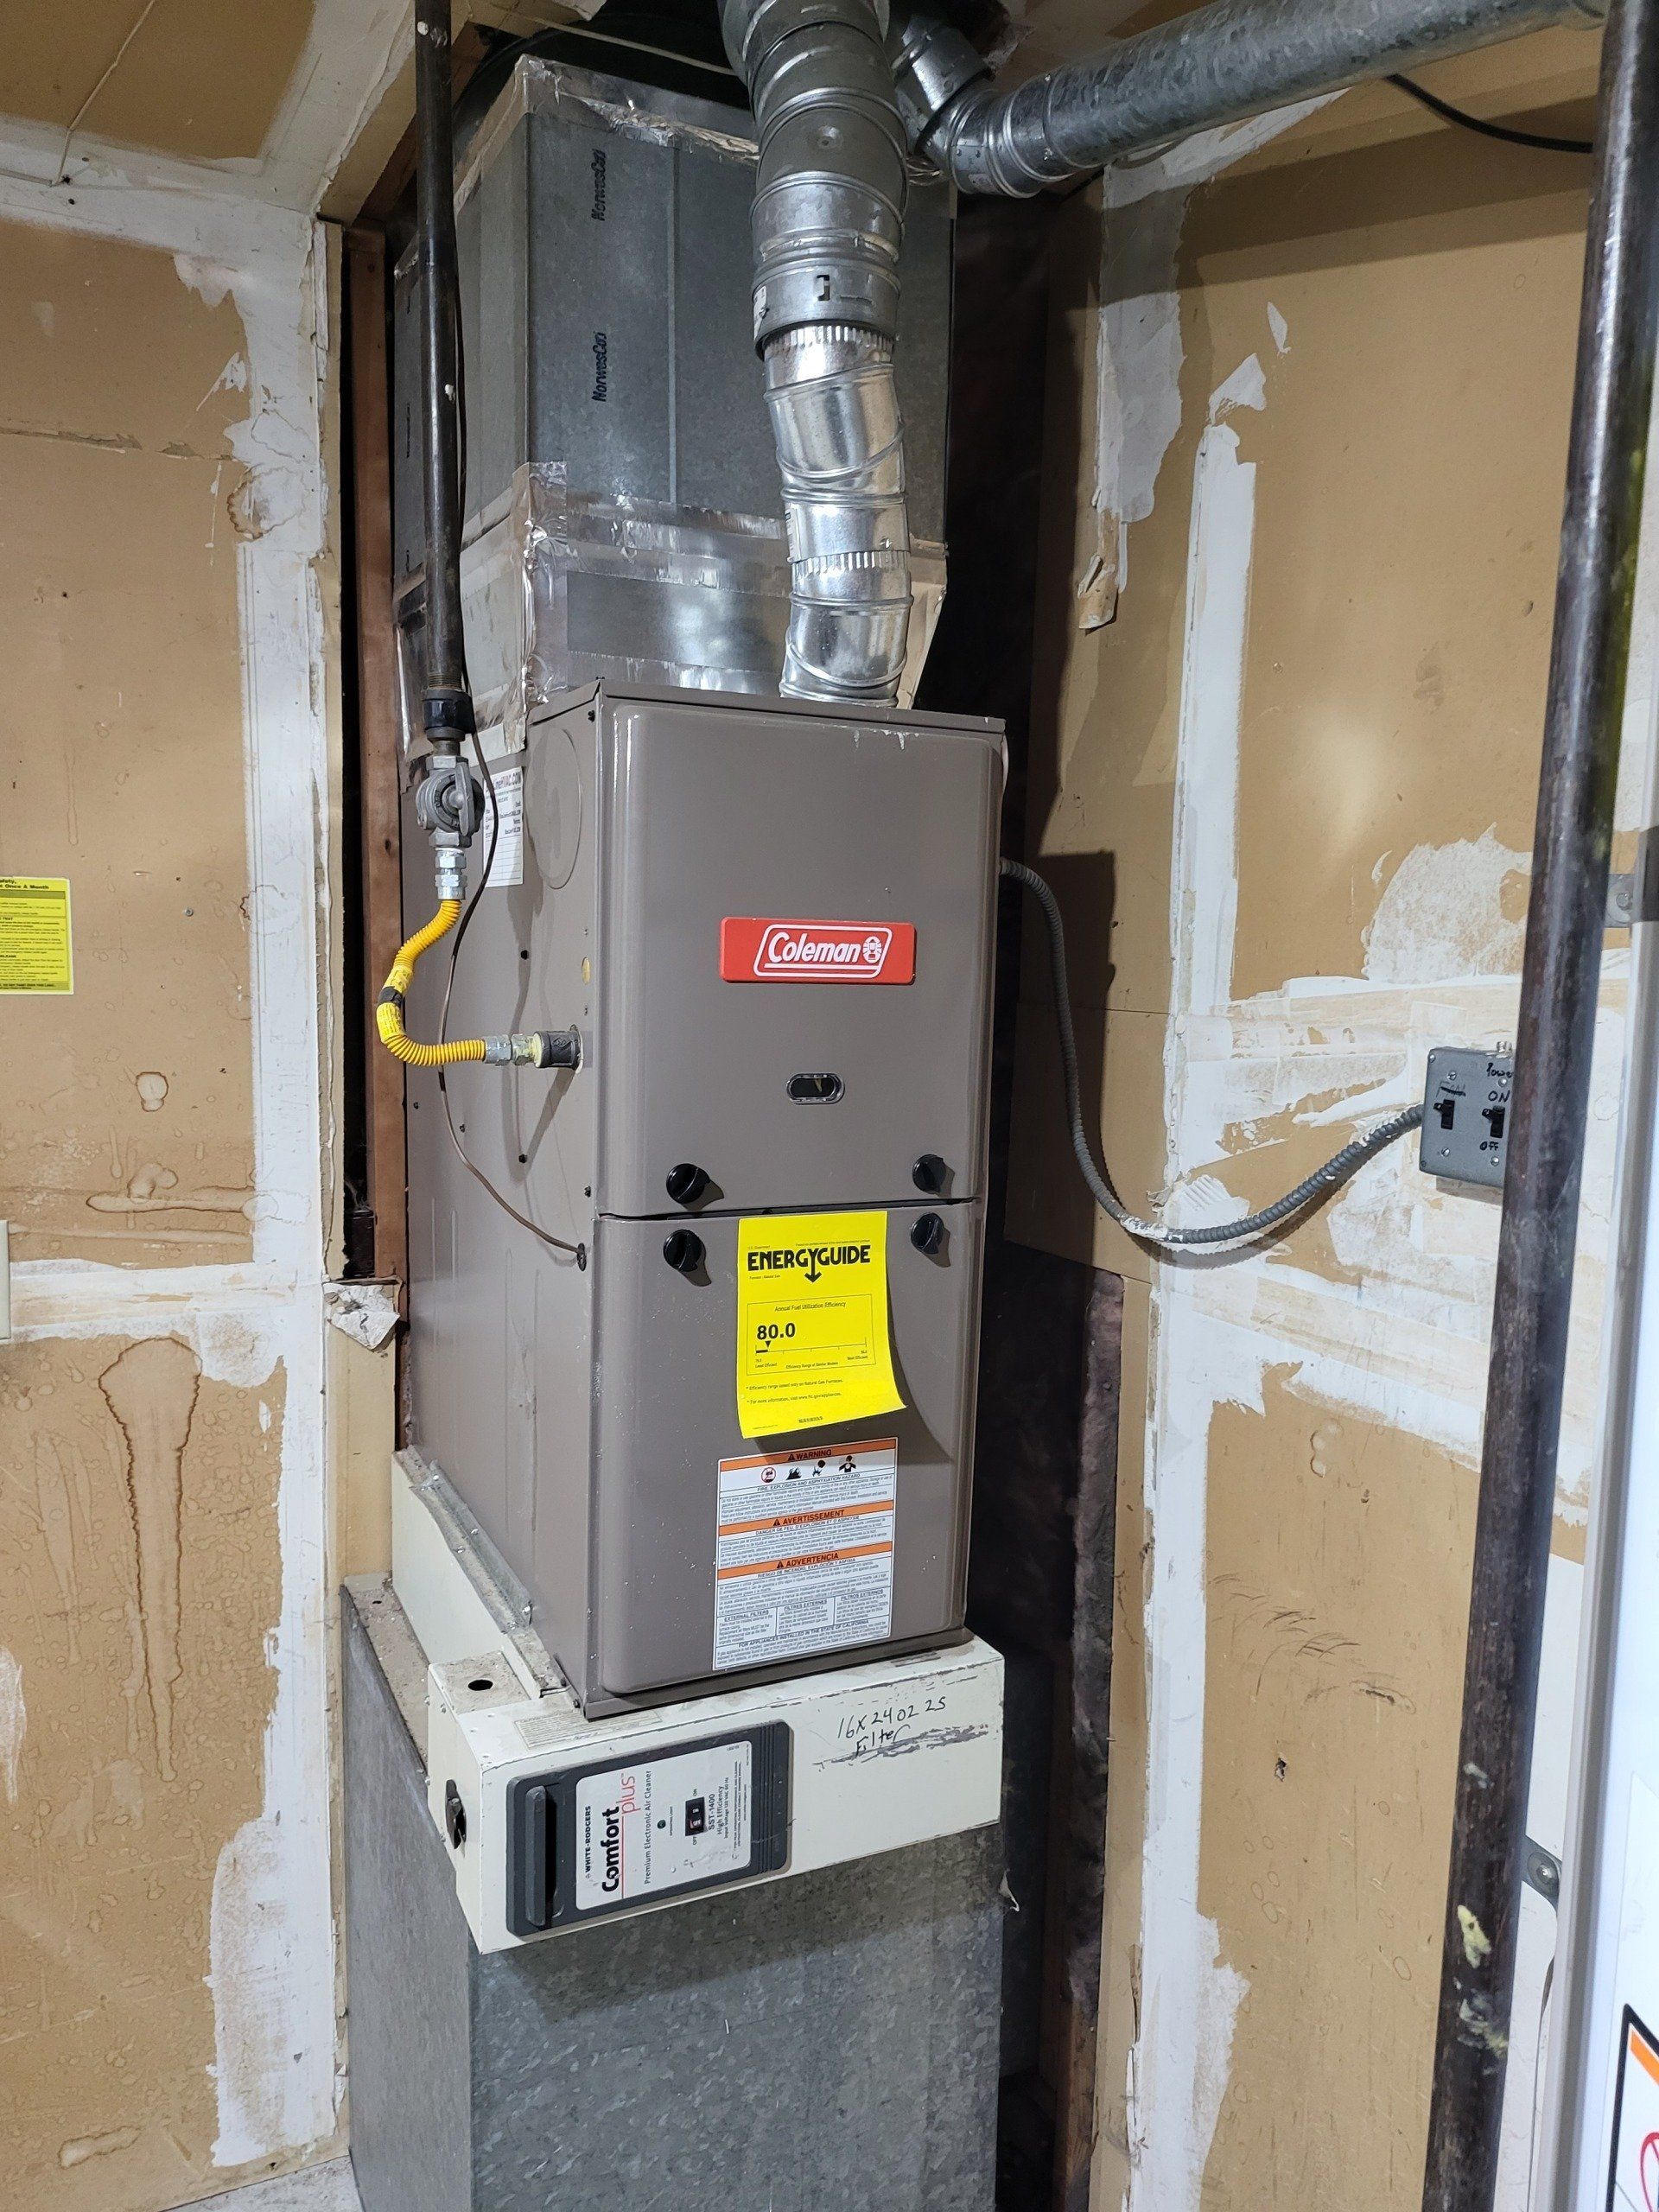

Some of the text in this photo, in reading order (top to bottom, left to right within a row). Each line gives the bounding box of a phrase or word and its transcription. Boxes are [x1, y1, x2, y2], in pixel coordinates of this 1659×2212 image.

[768, 931, 861, 963] Coleman
[1488, 1090, 1510, 1103] ON
[1479, 1141, 1499, 1151] OFF
[747, 1245, 871, 1274] ENERGYGUIDE
[757, 1323, 796, 1339] 80.0
[797, 1449, 831, 1459] WARNING
[783, 1510, 844, 1524] AVERTISSEMENT
[785, 1552, 838, 1566] ADVERTENCIA
[601, 1807, 620, 1892] Comfort
